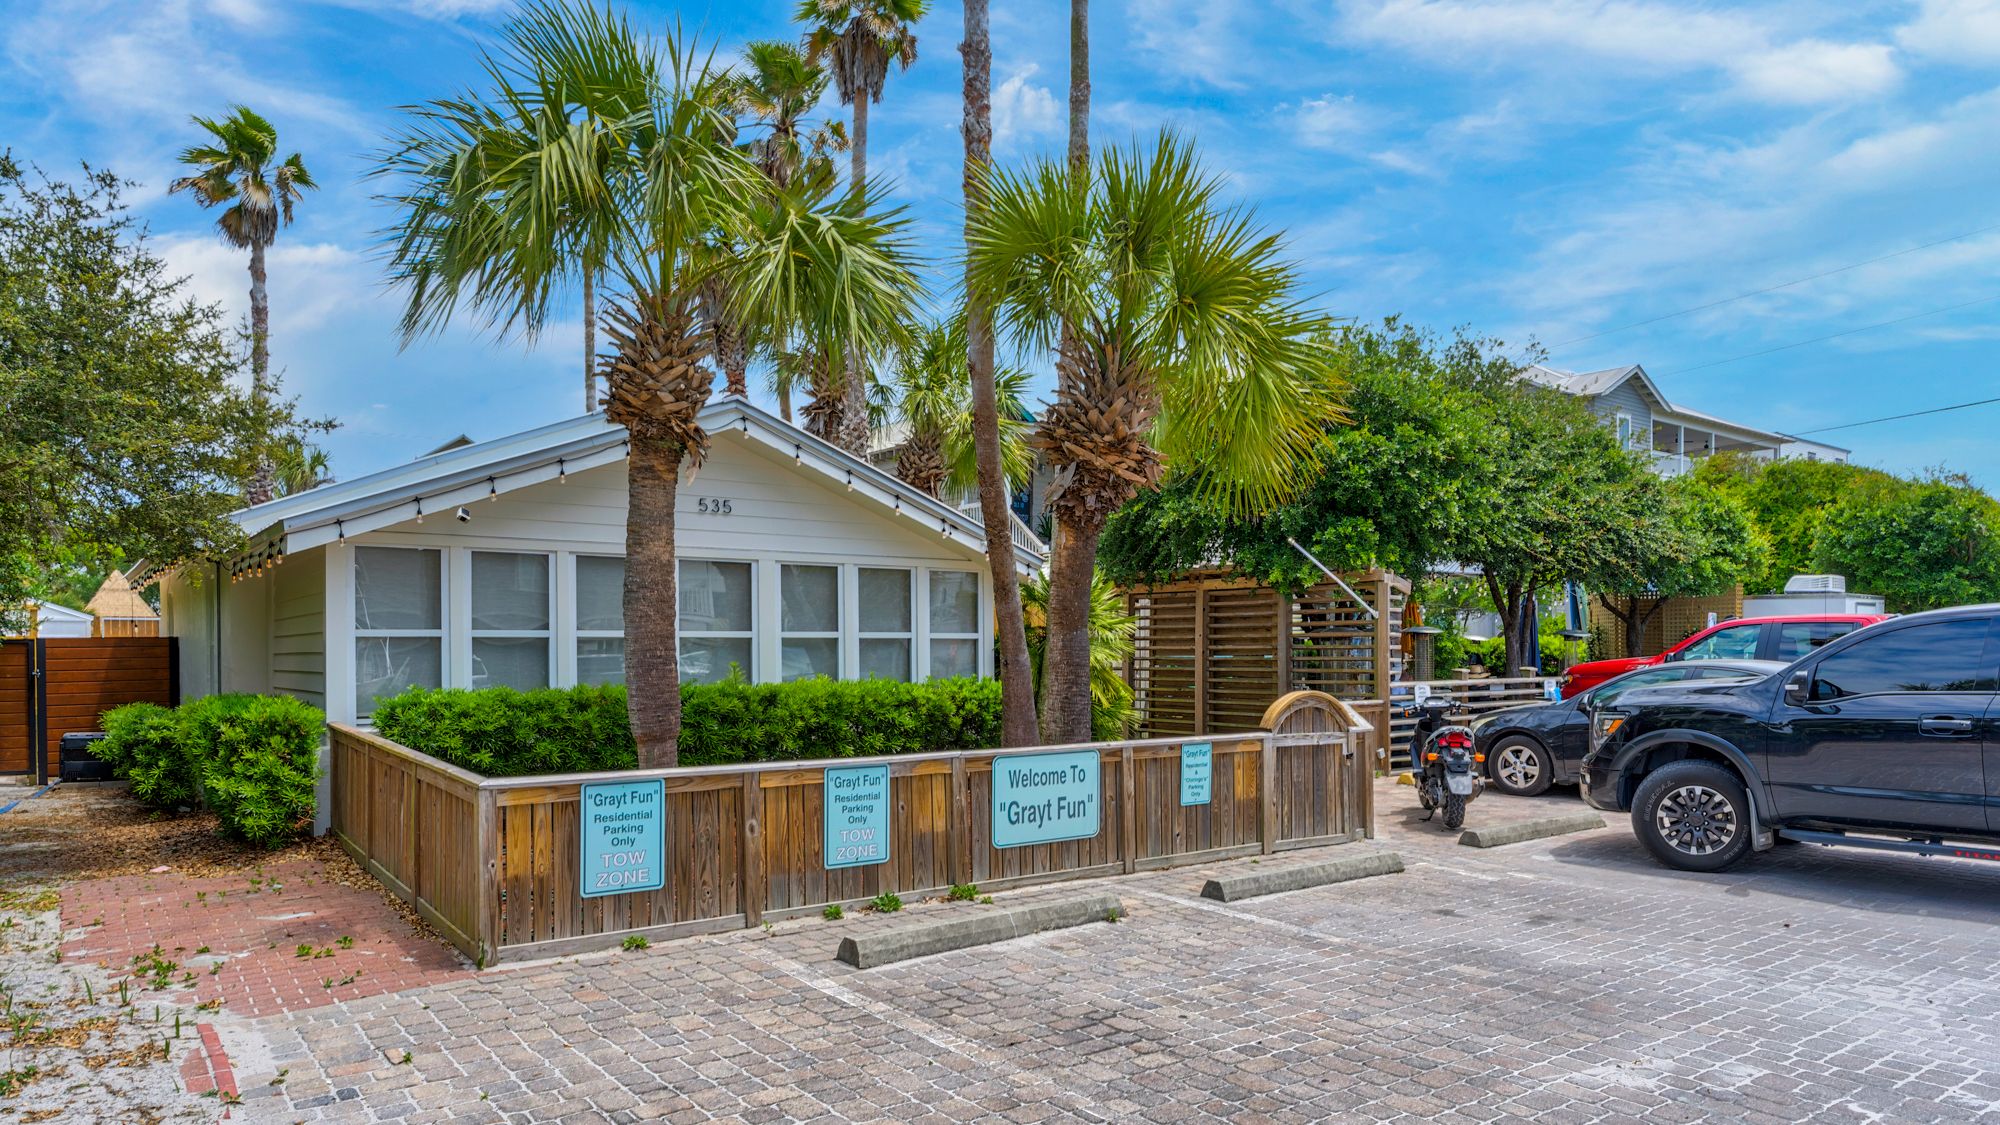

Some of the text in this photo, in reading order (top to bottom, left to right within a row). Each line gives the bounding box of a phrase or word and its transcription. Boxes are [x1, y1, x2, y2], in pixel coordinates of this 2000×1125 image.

[698, 498, 732, 514] 535
[830, 773, 885, 790] "Grayt Fun"
[1008, 764, 1086, 789] Welcome To
[588, 789, 658, 808] "Grayt Fun"
[834, 792, 881, 803] Residential
[594, 810, 653, 823] Residential
[841, 804, 874, 814] Parking
[1000, 793, 1093, 829] "Grayt Fun"
[848, 815, 868, 825] Only
[603, 824, 644, 835] Parking
[840, 827, 875, 843] TOW
[611, 836, 636, 847] Only
[601, 849, 646, 868] TOW
[836, 844, 878, 861] ZONE
[595, 868, 650, 888] ZONE
